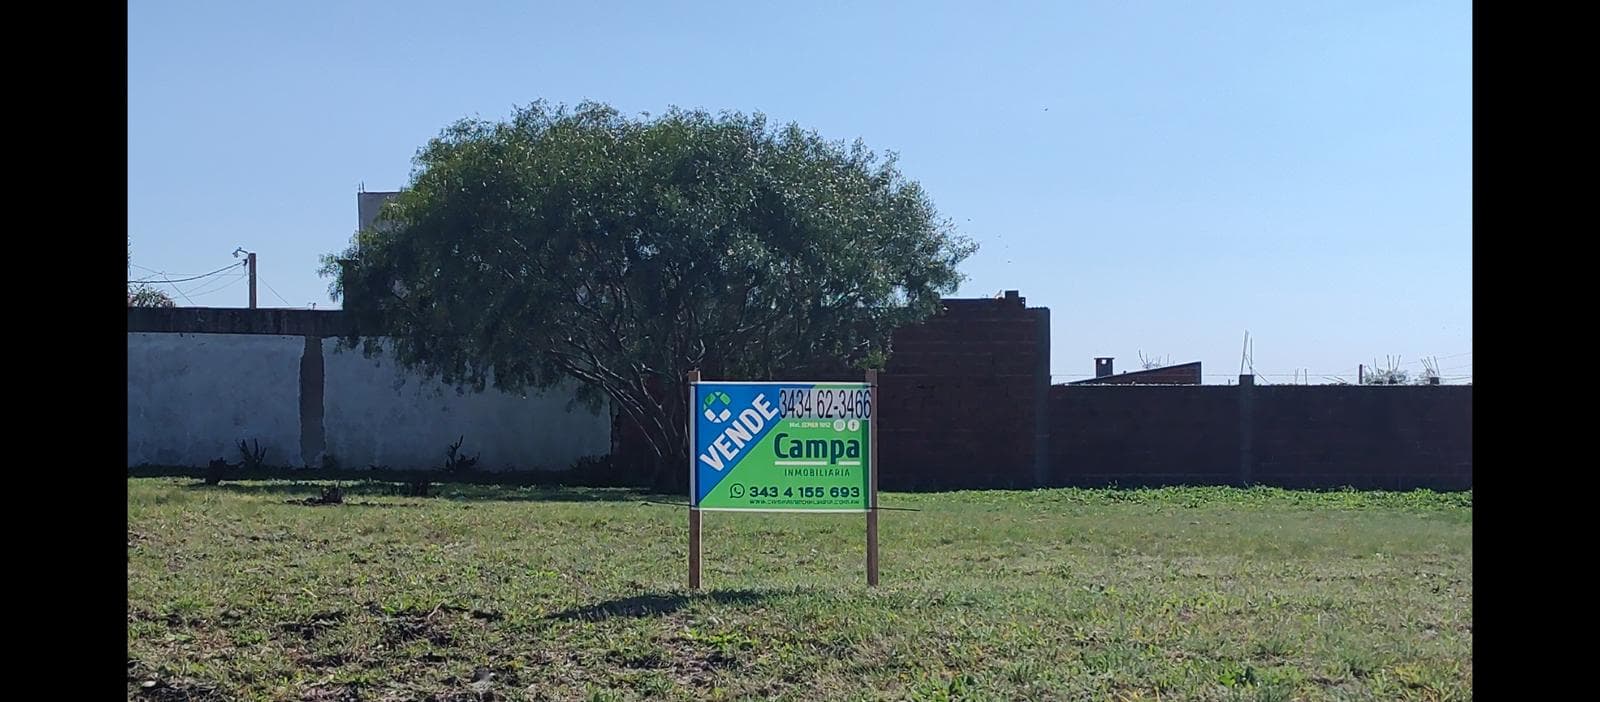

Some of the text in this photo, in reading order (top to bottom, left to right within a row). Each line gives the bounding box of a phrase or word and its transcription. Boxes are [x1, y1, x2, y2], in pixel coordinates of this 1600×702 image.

[700, 393, 779, 471] VENDE
[773, 433, 860, 464] Campa
[784, 469, 850, 477] INMOBILIARIA
[749, 487, 860, 497] 343 4 155 693
